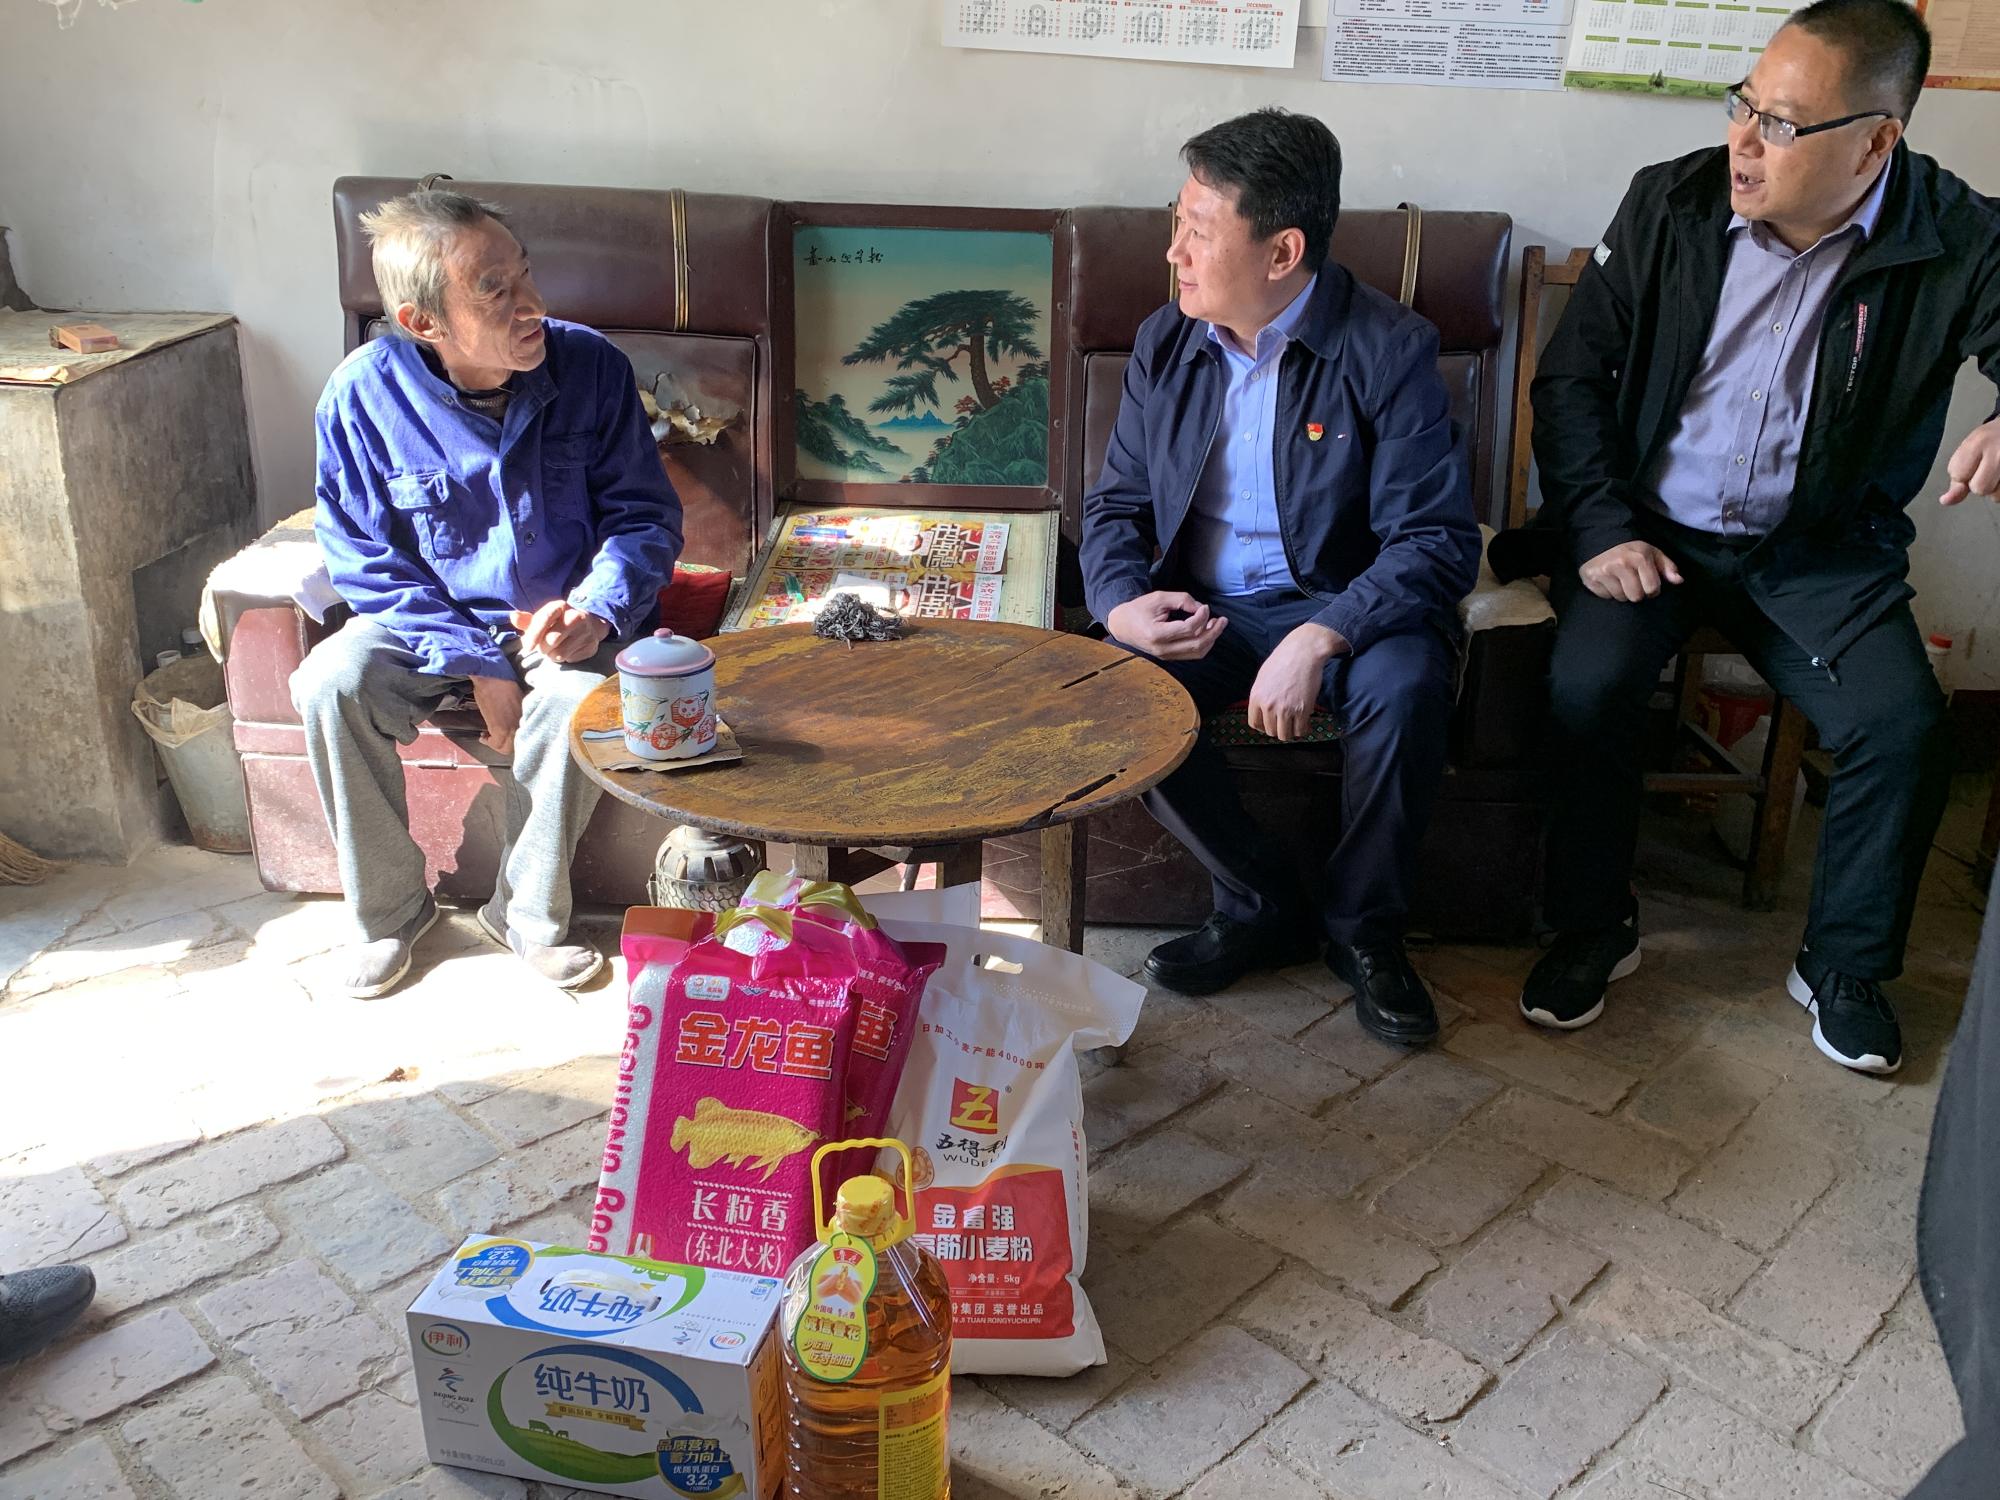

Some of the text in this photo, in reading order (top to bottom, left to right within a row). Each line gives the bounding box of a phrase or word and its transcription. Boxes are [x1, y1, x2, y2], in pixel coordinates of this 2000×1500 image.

[1027, 4, 1047, 35] 8
[1083, 7, 1102, 39] 9
[1131, 11, 1163, 41] 10
[1188, 15, 1218, 46] 11
[1241, 17, 1275, 49] 12
[675, 1011, 836, 1080] 金龙鱼
[951, 1086, 998, 1130] 五
[692, 1189, 789, 1232] 长粒香
[685, 1234, 782, 1276] (东北大米)
[538, 1286, 646, 1324] 纯牛奶
[992, 1303, 1044, 1316] 荣誉出品
[427, 1330, 463, 1349] 伊利
[534, 1363, 650, 1413] 纯牛奶
[673, 1465, 720, 1474] 优质乳蛋白
